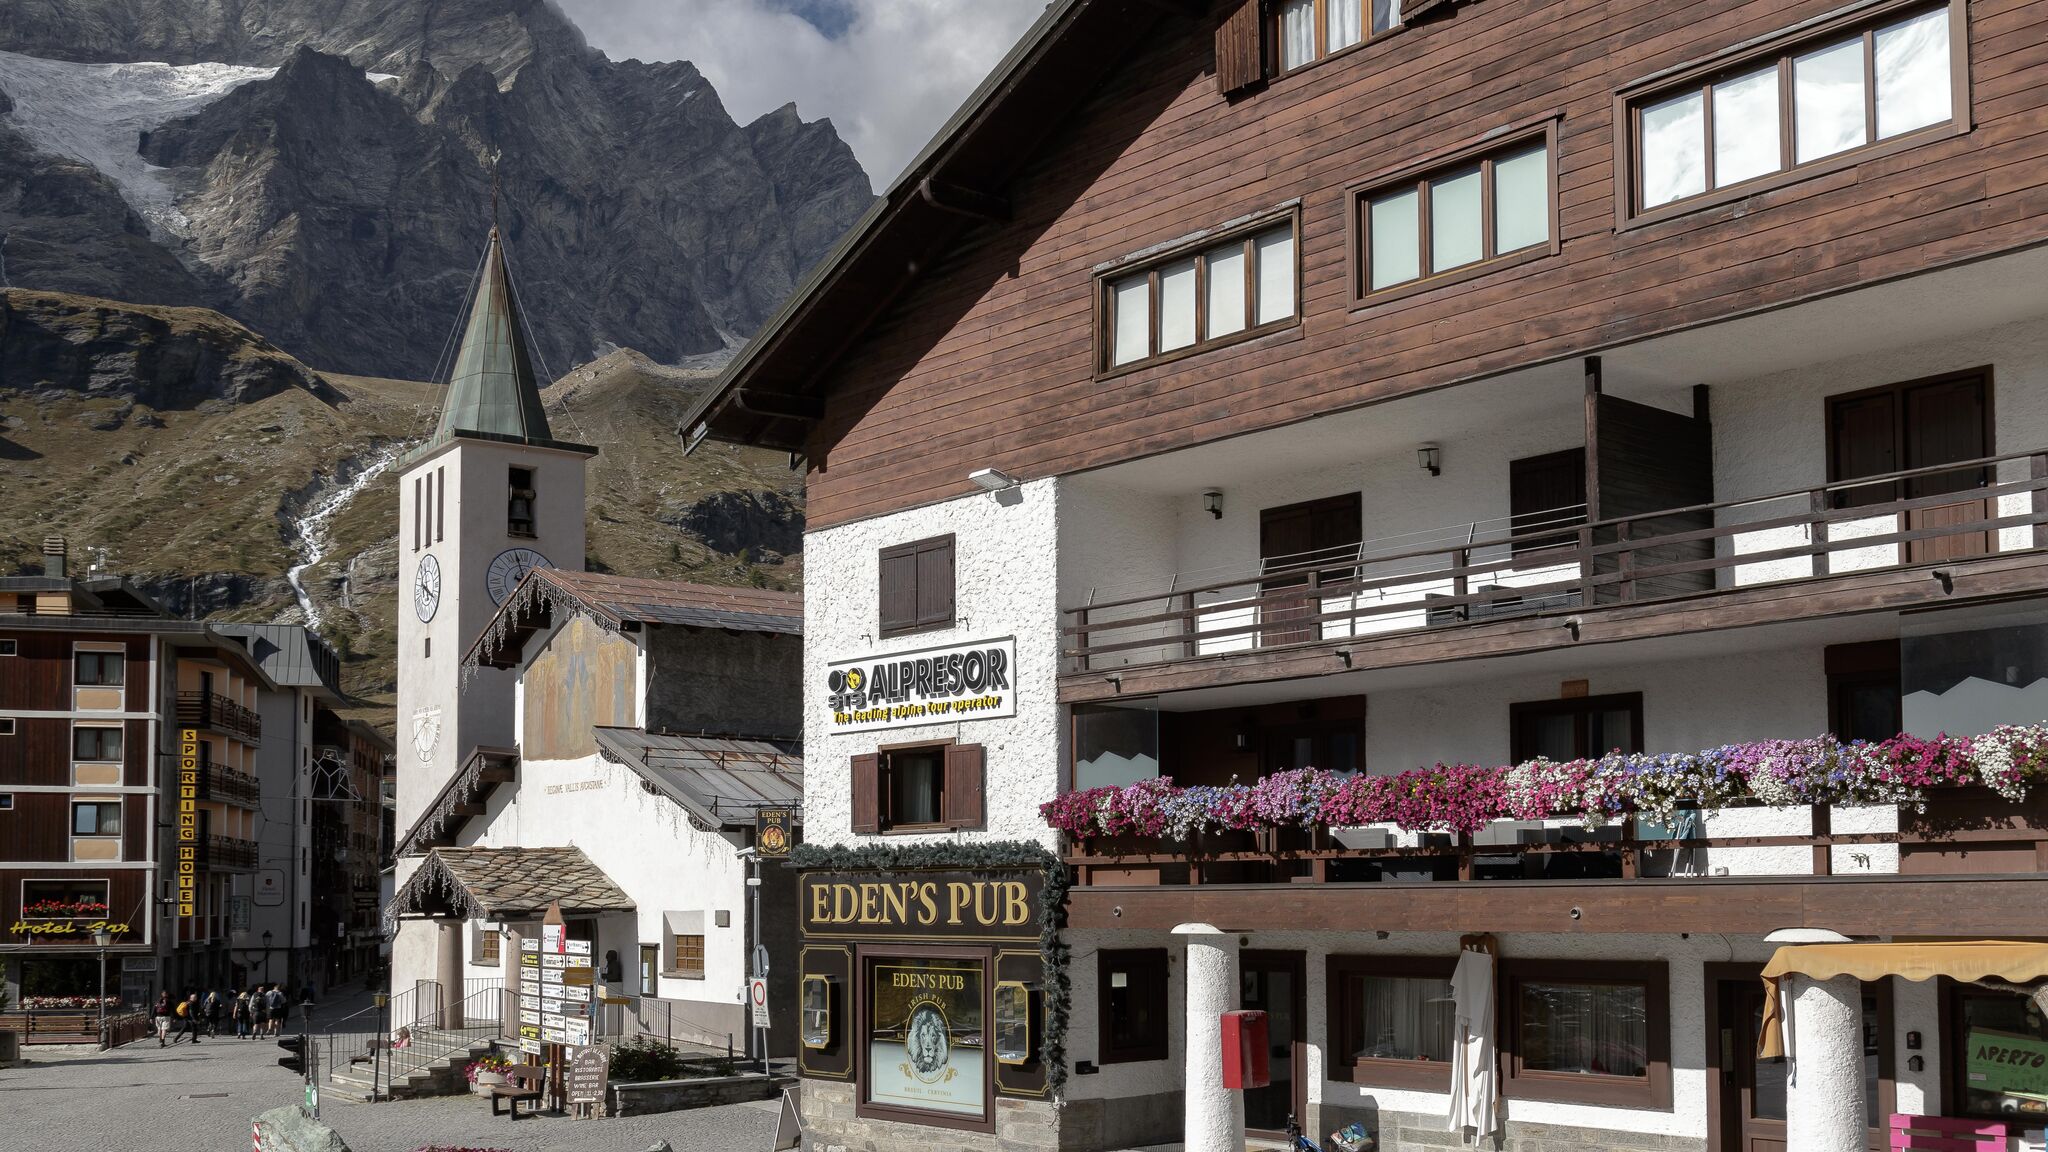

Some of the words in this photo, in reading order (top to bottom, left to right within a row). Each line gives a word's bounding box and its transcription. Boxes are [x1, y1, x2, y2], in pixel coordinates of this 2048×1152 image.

[868, 648, 1009, 705] ALPRESOR
[834, 711, 850, 725] The
[853, 707, 889, 722] leading
[892, 703, 924, 718] alpine
[927, 701, 948, 714] tour
[952, 696, 1000, 712] operator
[180, 730, 196, 840] SPORTING
[179, 847, 195, 916] HOTEL
[810, 880, 938, 925] EDEN'S
[947, 881, 1030, 926] PUB
[10, 921, 76, 934] Hotel
[893, 972, 936, 989] EDEN'S
[939, 975, 964, 990] PUB
[908, 993, 928, 1009] IRISH
[931, 994, 947, 1009] PUB
[1976, 1045, 2046, 1068] APERTO
